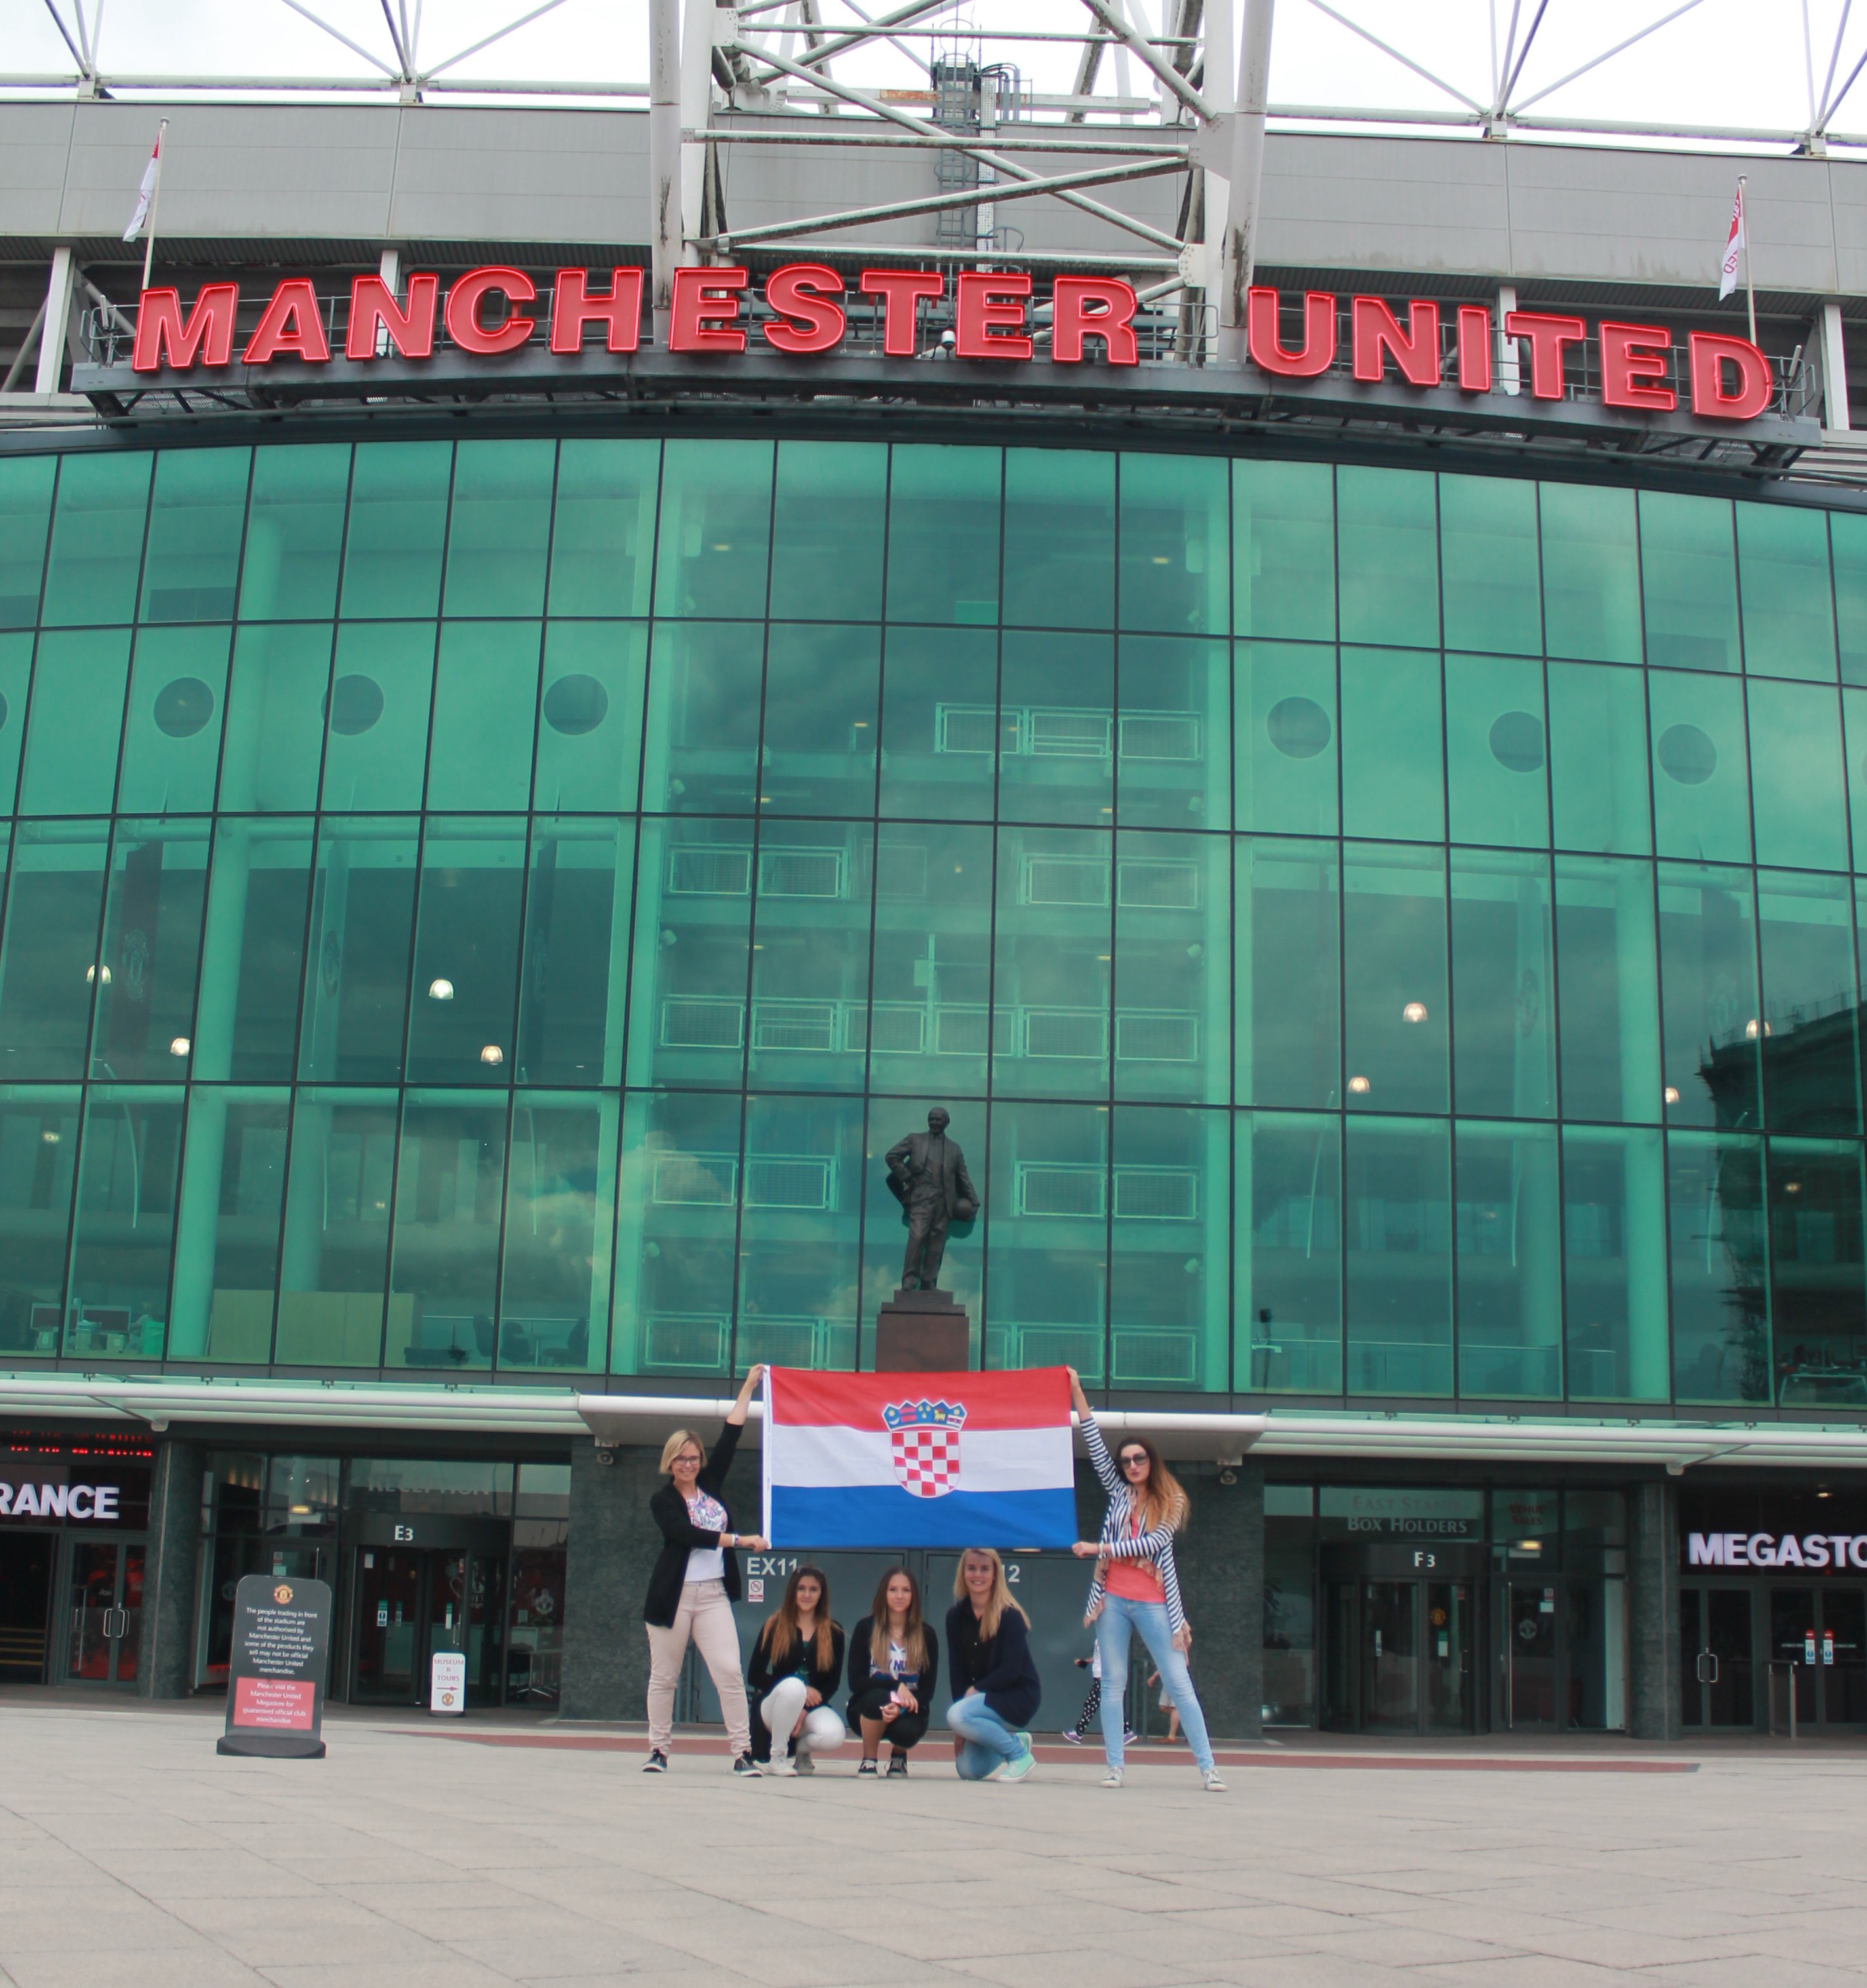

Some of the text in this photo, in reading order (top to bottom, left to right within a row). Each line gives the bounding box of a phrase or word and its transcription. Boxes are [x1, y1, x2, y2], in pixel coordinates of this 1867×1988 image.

[132, 263, 1773, 420] MANCHESTER UNITED
[395, 1525, 414, 1541] E3
[1348, 1516, 1468, 1534] BOX HOLDERS
[747, 1557, 797, 1576] EX11
